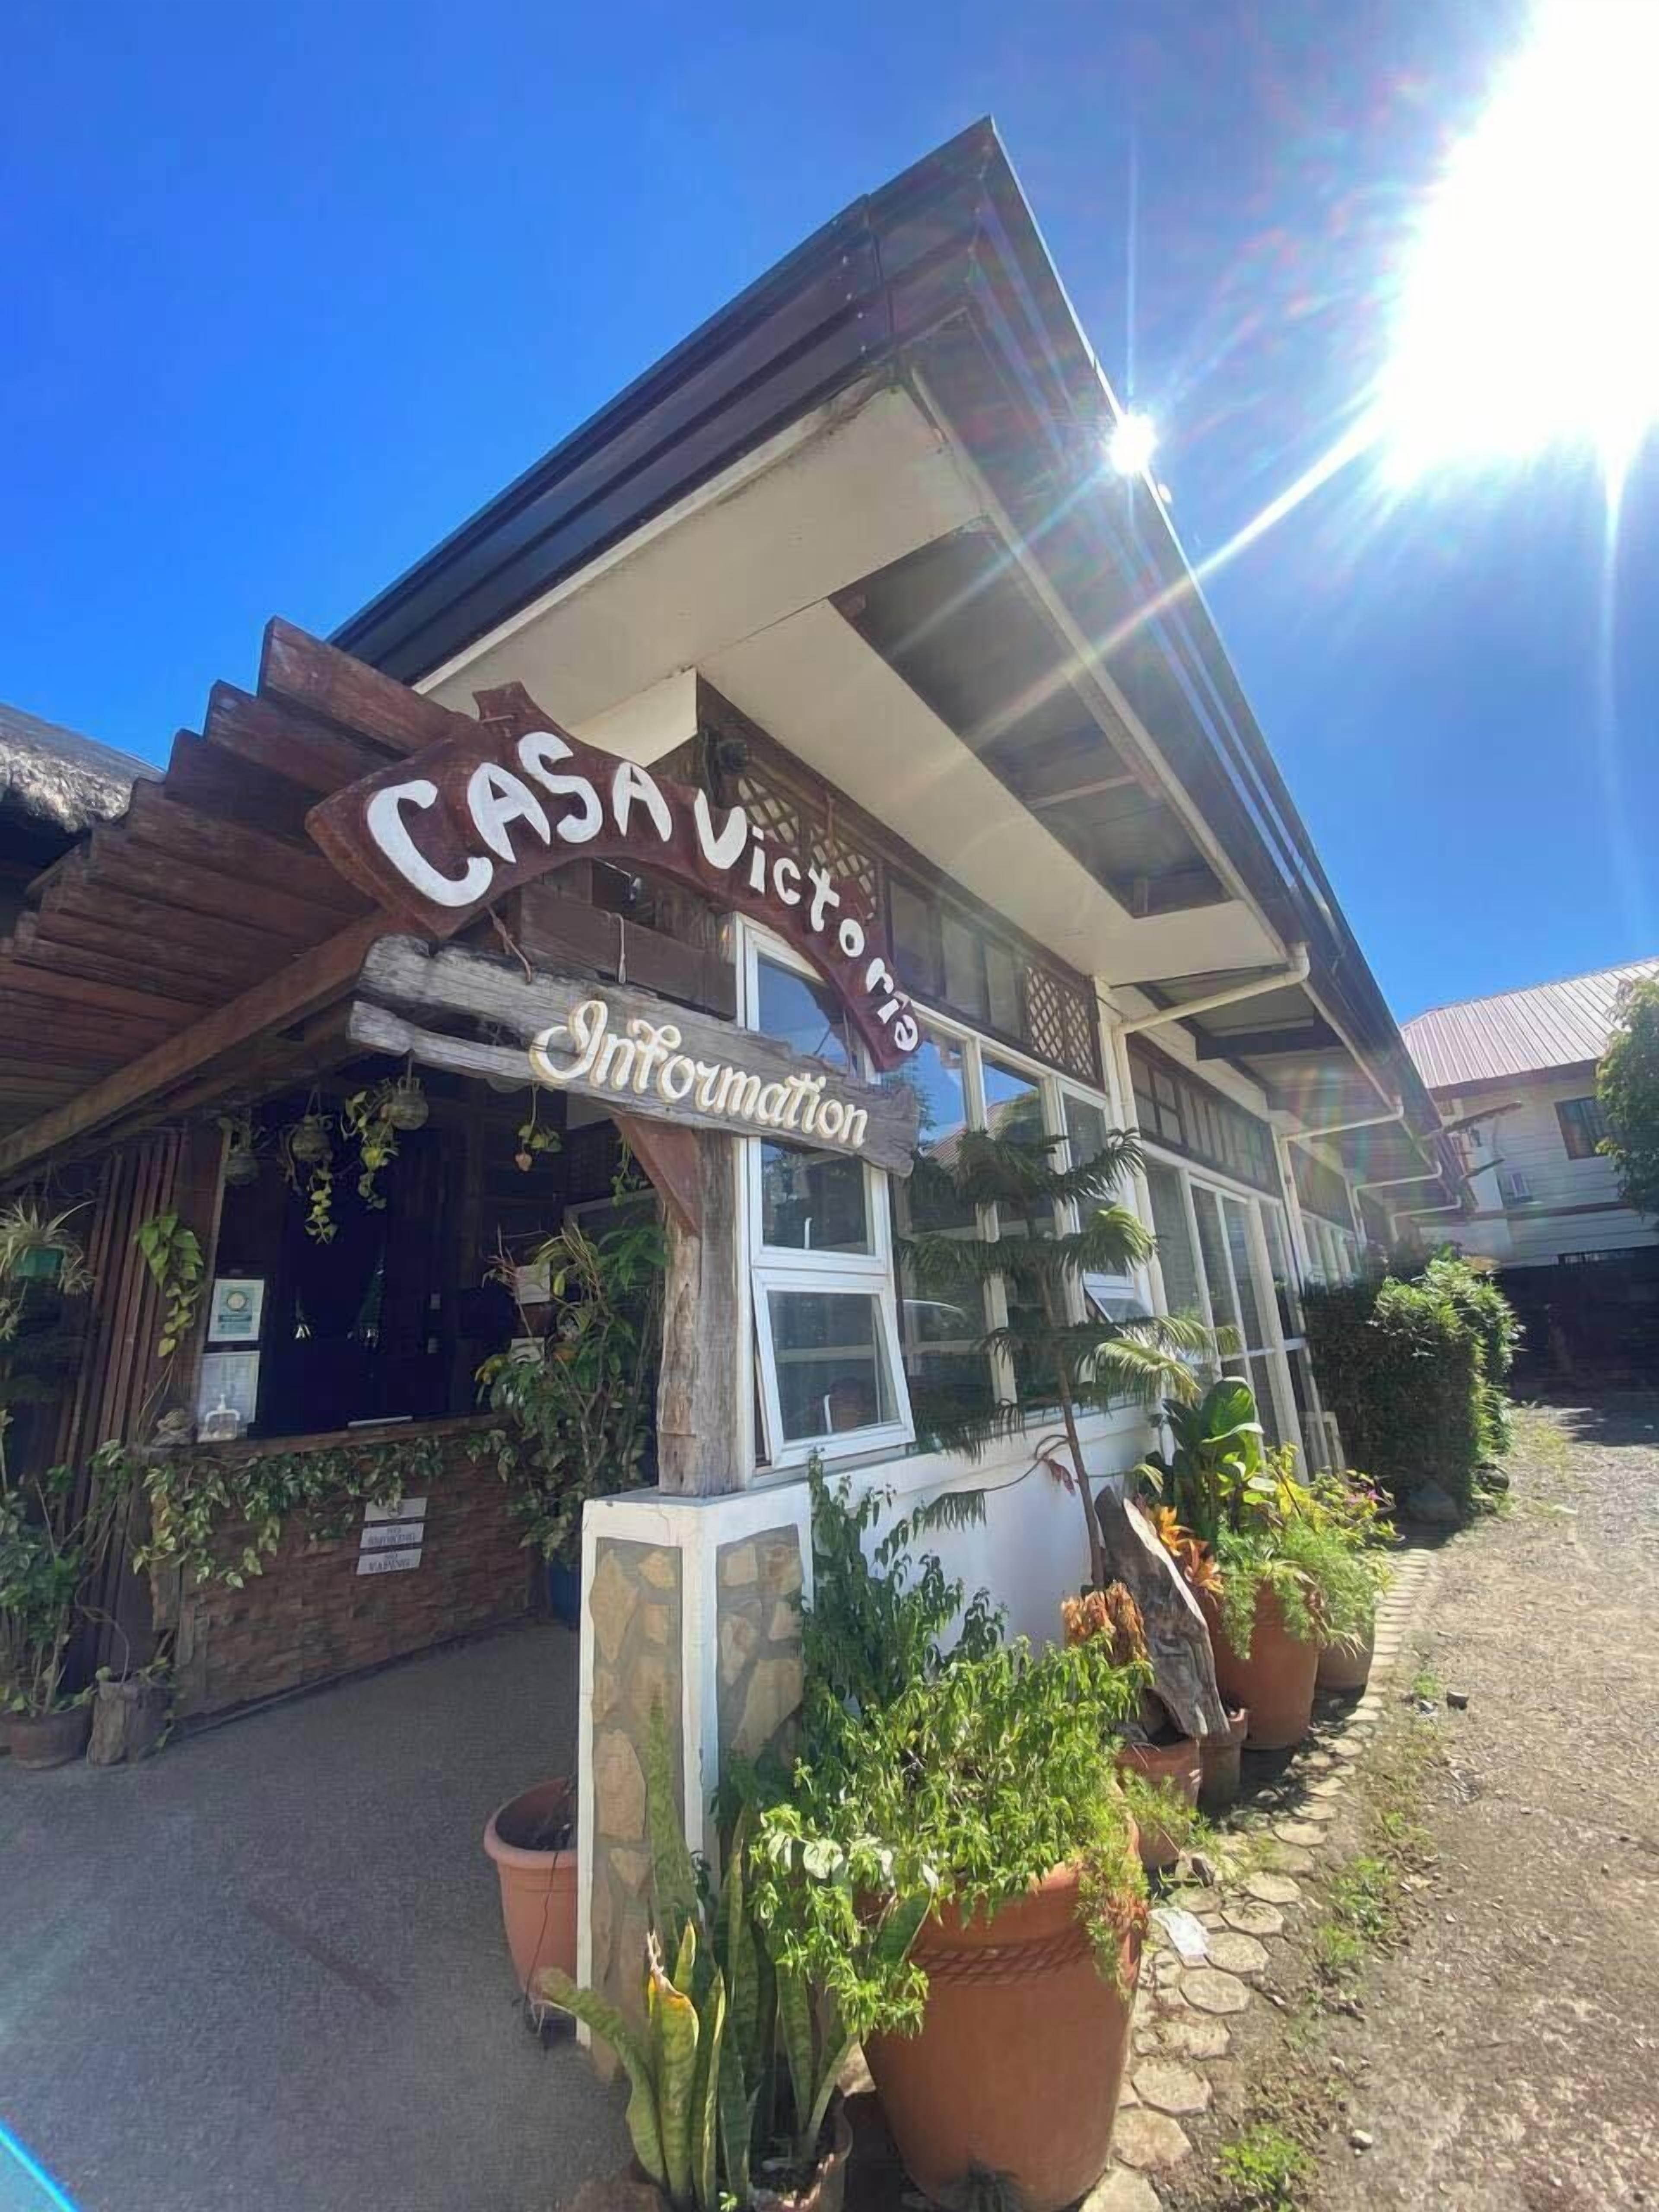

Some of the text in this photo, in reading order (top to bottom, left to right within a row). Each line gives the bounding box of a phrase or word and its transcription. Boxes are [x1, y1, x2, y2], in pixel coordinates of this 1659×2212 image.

[366, 731, 918, 1052] CASA Victoria
[529, 1000, 868, 1147] Information
